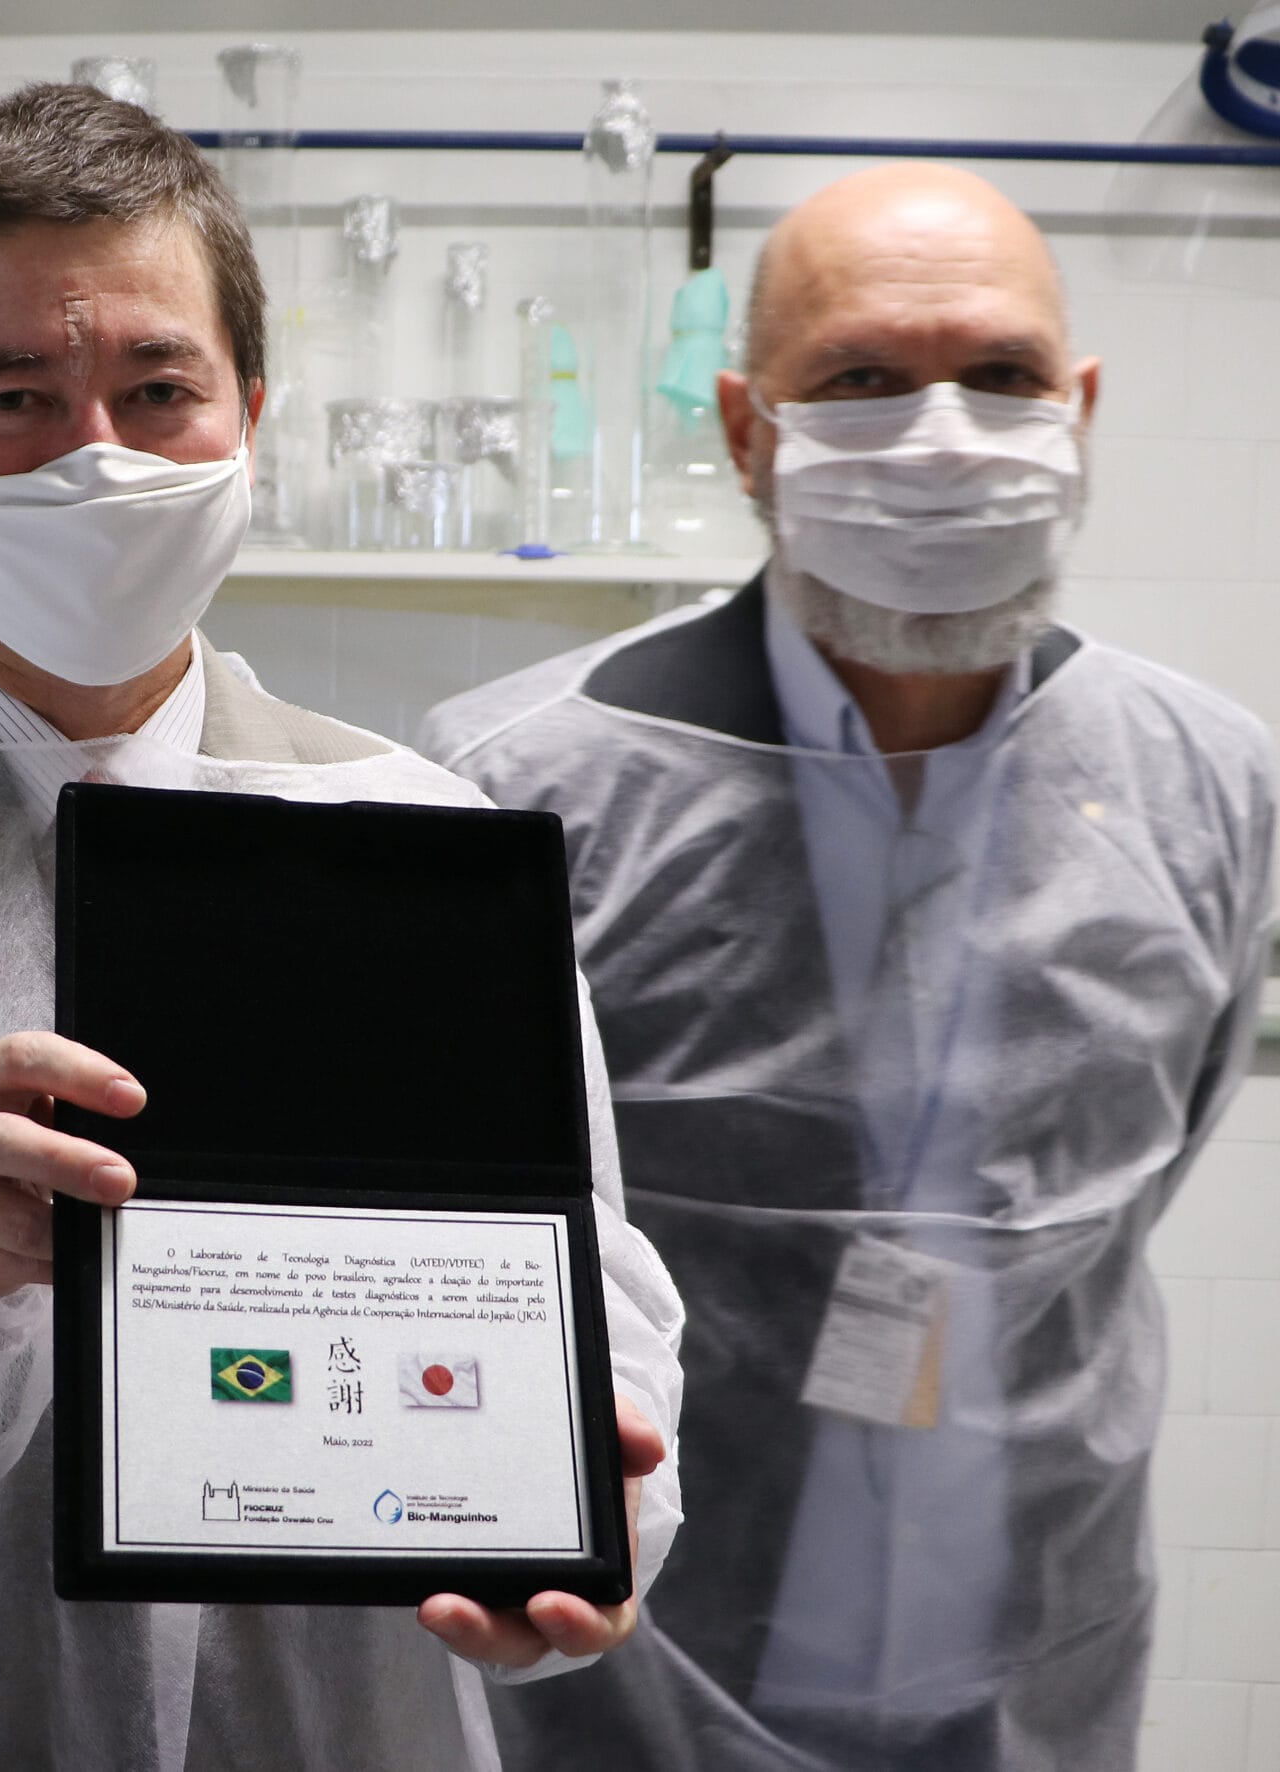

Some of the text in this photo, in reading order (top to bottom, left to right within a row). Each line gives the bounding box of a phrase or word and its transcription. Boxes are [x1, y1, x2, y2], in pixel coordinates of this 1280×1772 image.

[167, 1248, 542, 1270] O Laboratório de Tecnologia Diagnóstica (LATED/VDTEC) de Bio-
[132, 1264, 228, 1278] Manguinhos/Fiocruz,
[256, 1272, 281, 1280] nome
[287, 1270, 299, 1280] do
[305, 1273, 327, 1284] povo
[333, 1271, 376, 1284] brasileiro,
[383, 1274, 422, 1286] agradece
[440, 1275, 472, 1287] doação
[478, 1275, 489, 1286] do
[496, 1276, 544, 1288] importante
[132, 1282, 192, 1293] equipamento
[200, 1286, 221, 1296] para
[230, 1284, 303, 1298] desenvolvimento
[312, 1288, 324, 1298] de
[332, 1290, 356, 1298] testes
[364, 1288, 420, 1302] diagnósticos
[476, 1292, 520, 1304] utilizados
[527, 1294, 546, 1306] pelo
[132, 1298, 202, 1312] SUS/Ministério
[203, 1300, 215, 1312] da
[216, 1302, 248, 1314] Saúde,
[249, 1302, 290, 1314] realizada
[292, 1304, 311, 1317] pela
[312, 1305, 348, 1318] Agência
[350, 1306, 362, 1317] de
[363, 1306, 415, 1320] Cooperação
[417, 1308, 476, 1320] Internacional
[478, 1308, 490, 1320] do
[490, 1310, 516, 1322] Japão
[327, 1336, 364, 1414] 感謝
[322, 1436, 374, 1448] Maio, 2022
[242, 1485, 279, 1494] Ministério
[292, 1486, 316, 1494] Saúde
[244, 1504, 284, 1512] FIOCRUZ
[244, 1515, 280, 1524] Fundação
[407, 1512, 498, 1524] Bio-Manguinhos
